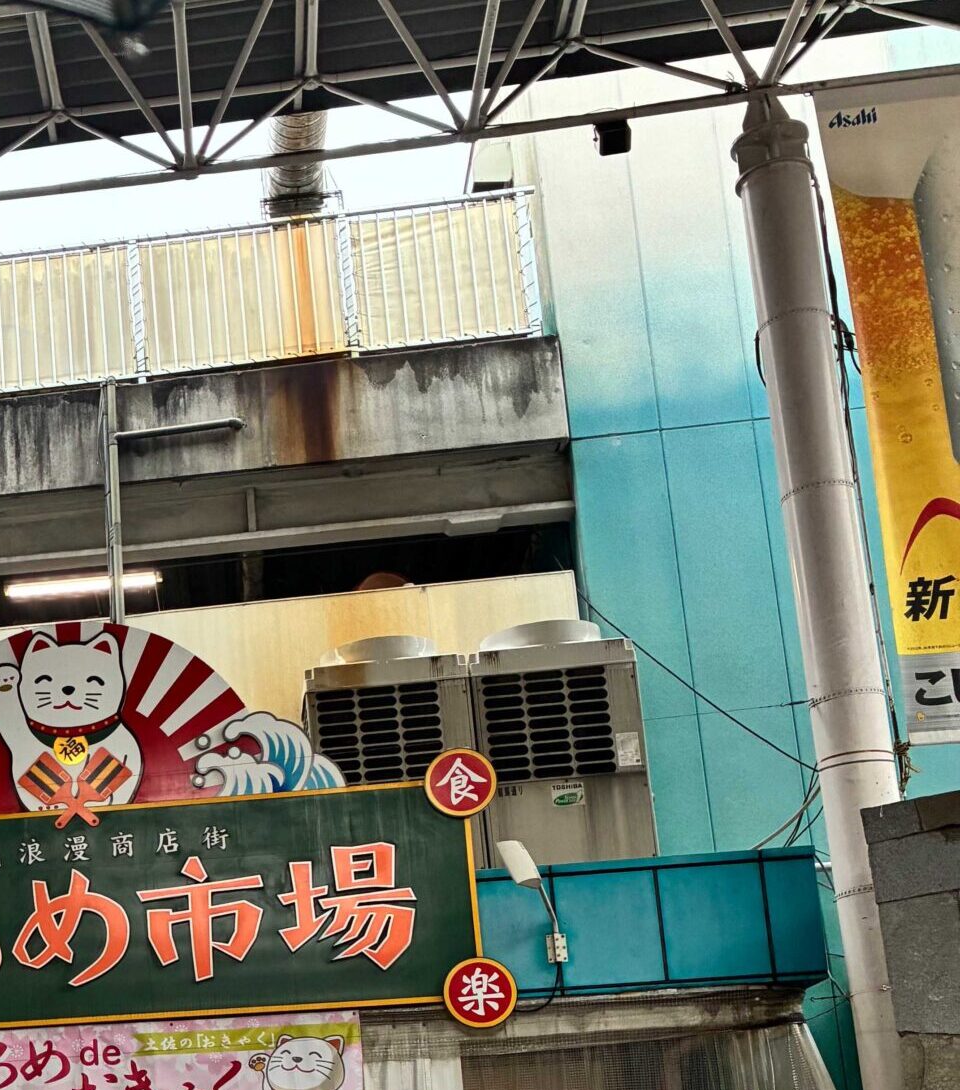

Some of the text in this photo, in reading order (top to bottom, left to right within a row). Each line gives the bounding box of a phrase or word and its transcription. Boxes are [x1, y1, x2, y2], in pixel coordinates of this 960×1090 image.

[828, 107, 877, 128] Asahi
[904, 575, 956, 621] 新
[59, 737, 86, 761] 福
[436, 758, 488, 805] 食
[552, 783, 583, 791] TOSHIBA
[457, 967, 505, 1016] 楽
[79, 1039, 121, 1067] de
